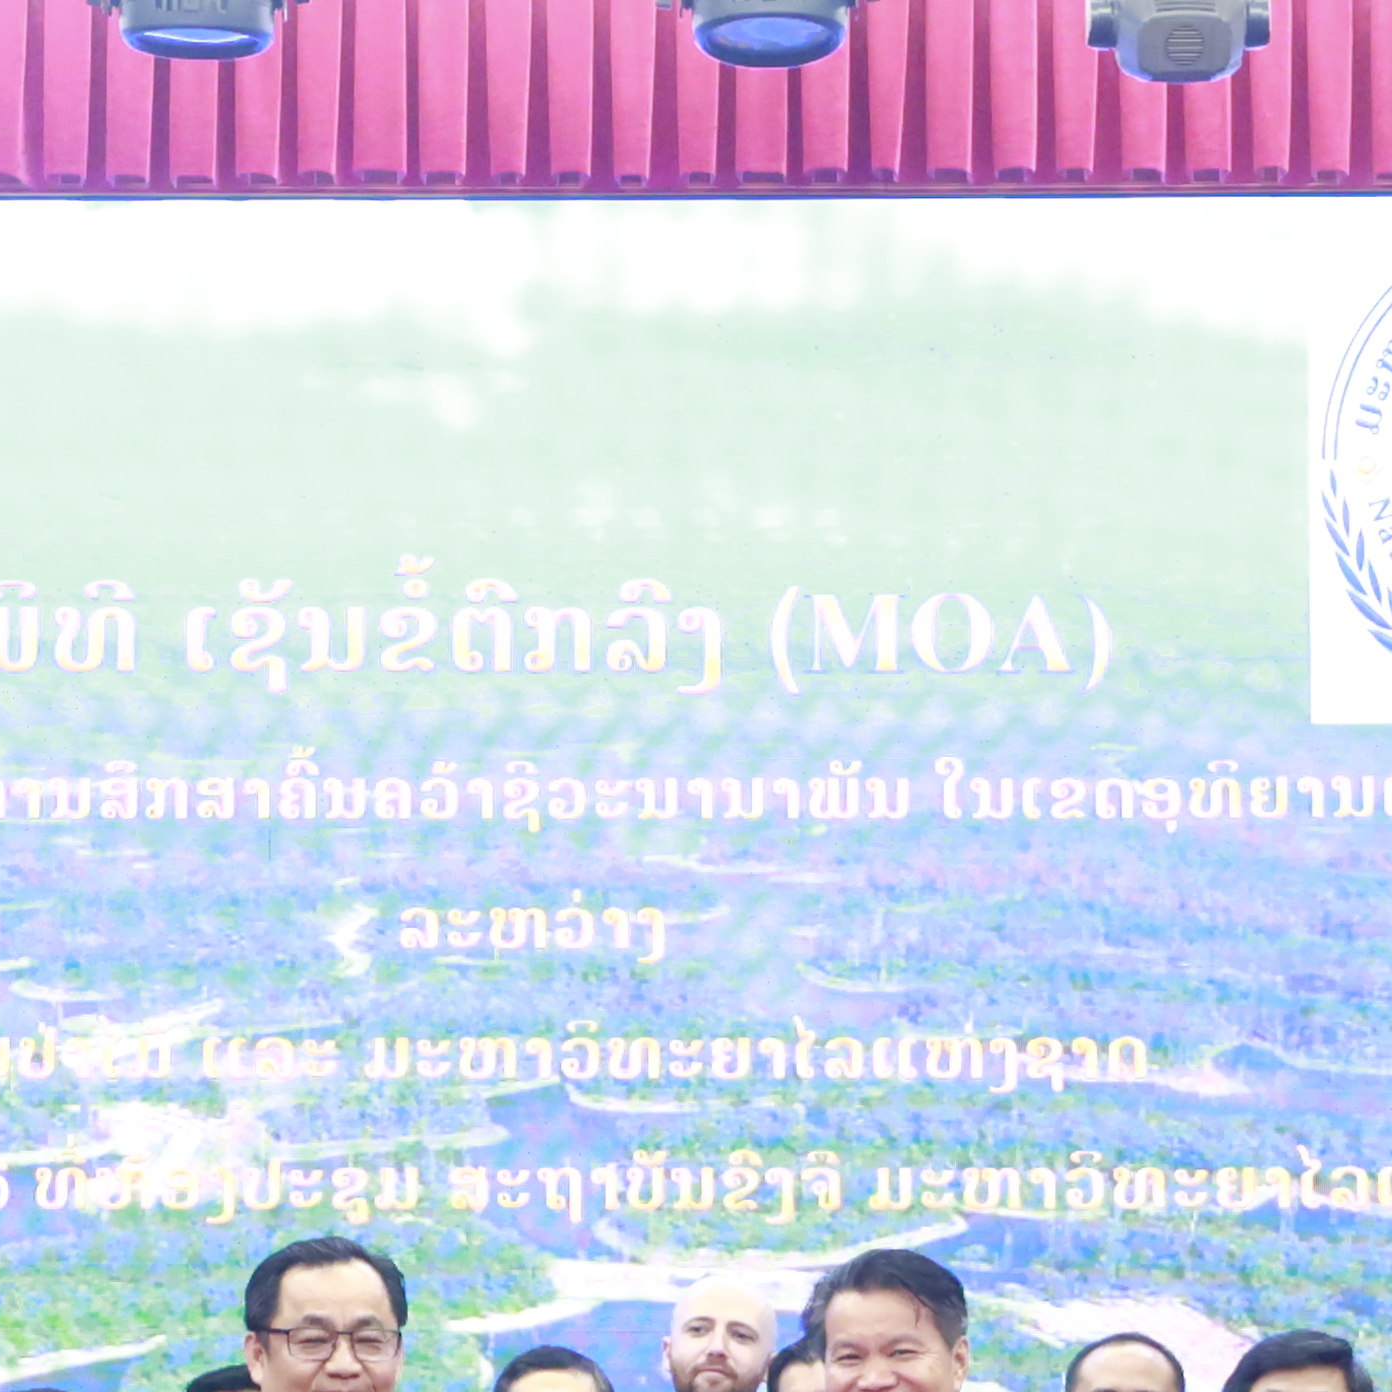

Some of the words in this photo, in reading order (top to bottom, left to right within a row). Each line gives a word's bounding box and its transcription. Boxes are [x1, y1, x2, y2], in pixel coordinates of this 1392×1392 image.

[770, 585, 1112, 696] (MOA)
[399, 888, 668, 965] ລະຫວ່າງ
[201, 1035, 338, 1079] ແລະ
